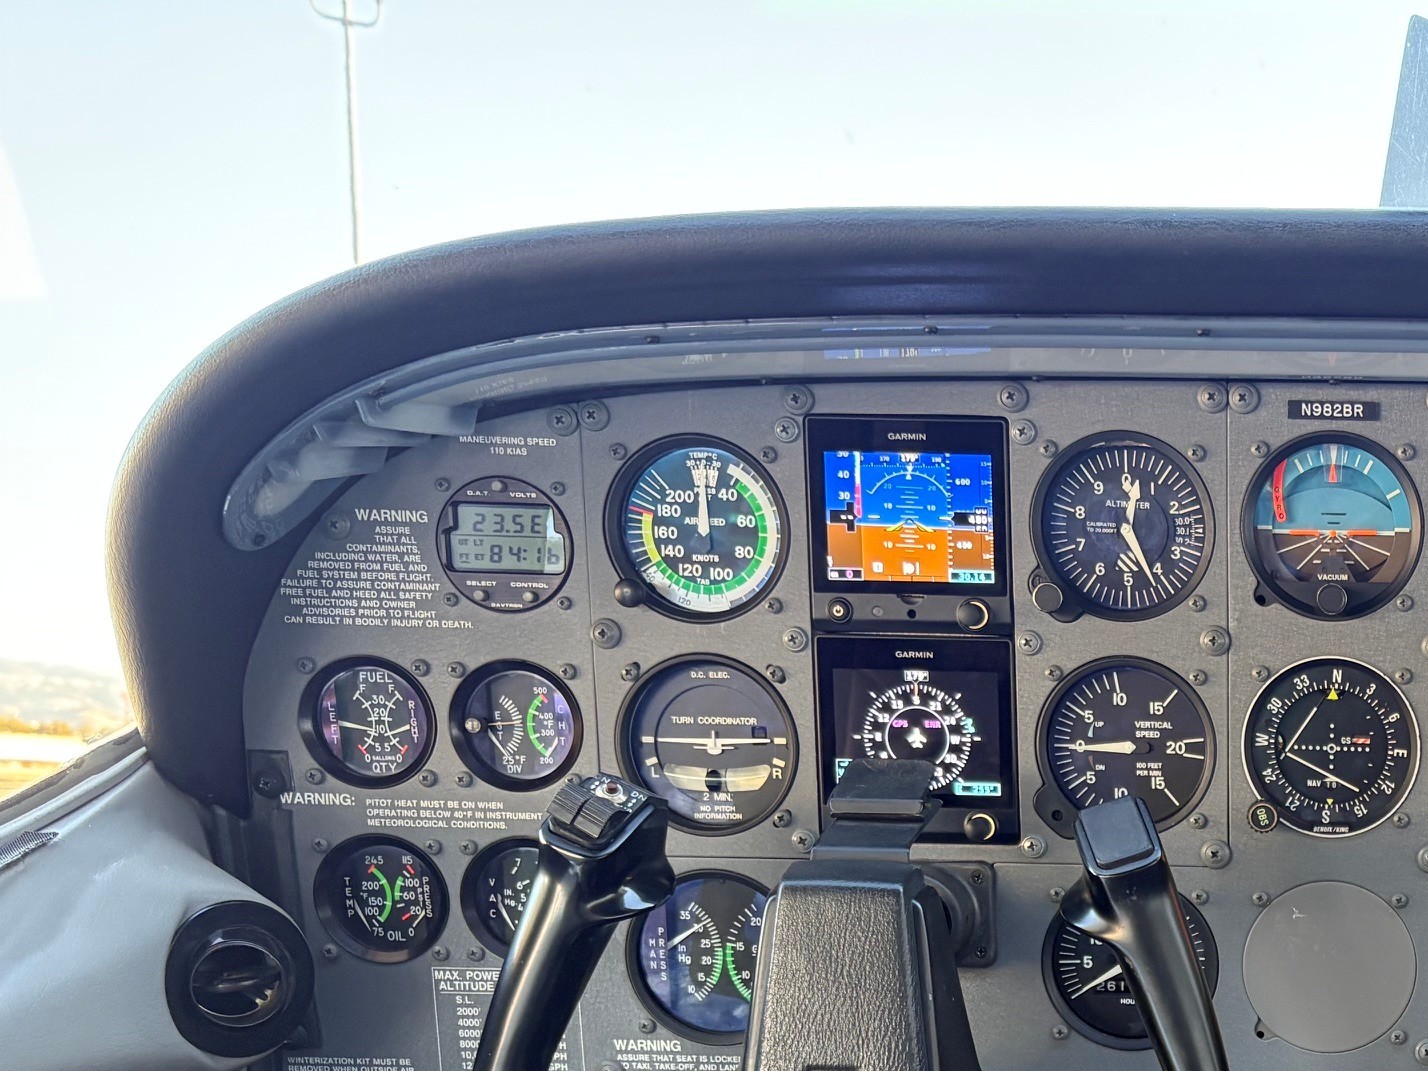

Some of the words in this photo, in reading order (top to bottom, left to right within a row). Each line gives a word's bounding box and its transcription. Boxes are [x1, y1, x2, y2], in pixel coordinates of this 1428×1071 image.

[1301, 403, 1363, 417] N982BR
[459, 436, 525, 445] MANEUVERING
[526, 438, 556, 446] SPEED
[888, 433, 926, 441] GARMIN
[490, 447, 504, 455] 110
[506, 448, 527, 456] KIAS
[665, 489, 694, 503] 200
[718, 489, 738, 502] 40
[355, 508, 428, 523] WARNING
[657, 504, 681, 517] 180
[737, 515, 756, 528] 60
[374, 526, 410, 534] ASSURE
[654, 526, 678, 539] 160
[374, 535, 398, 543] THAT
[400, 536, 417, 544] ALL
[346, 544, 421, 554] CONTAMINANTS,
[661, 544, 684, 557] 140
[735, 546, 754, 559] 80
[315, 552, 365, 561] INCLUDING
[367, 553, 401, 563] WATER,
[404, 554, 421, 563] ARE
[692, 554, 719, 562] KNOTS
[678, 563, 701, 576] 120
[709, 567, 733, 580] 100
[284, 615, 304, 625] CAN
[306, 616, 340, 625] RESULT
[342, 617, 352, 626] IN
[355, 617, 389, 627] BODILY
[391, 618, 424, 628] INJURY
[426, 620, 439, 628] OR
[441, 620, 474, 629] DEATH.
[895, 651, 933, 659] GARMIN
[359, 671, 393, 683] FUEL
[1333, 669, 1342, 682] N
[372, 695, 385, 704] 30
[1113, 693, 1127, 706] 10
[1150, 702, 1164, 715] 15
[671, 716, 694, 724] TURN
[698, 717, 757, 726] COORDINATOR
[1135, 721, 1173, 729] VERTICAL
[1166, 742, 1185, 754] 20
[372, 762, 397, 774] QTY
[280, 792, 355, 806] WARNING:
[366, 799, 391, 807] PITOT
[395, 800, 417, 808] HEAT
[420, 800, 444, 808] MUST
[447, 801, 457, 809] BE
[460, 801, 474, 809] ON
[477, 802, 503, 810] WHEN
[367, 819, 448, 828] METEOROLOGICAL
[451, 821, 507, 830] CONDITIONS.
[434, 970, 463, 980] MAX.
[439, 981, 495, 991] ALTITUDE
[613, 1039, 681, 1052] WARNING
